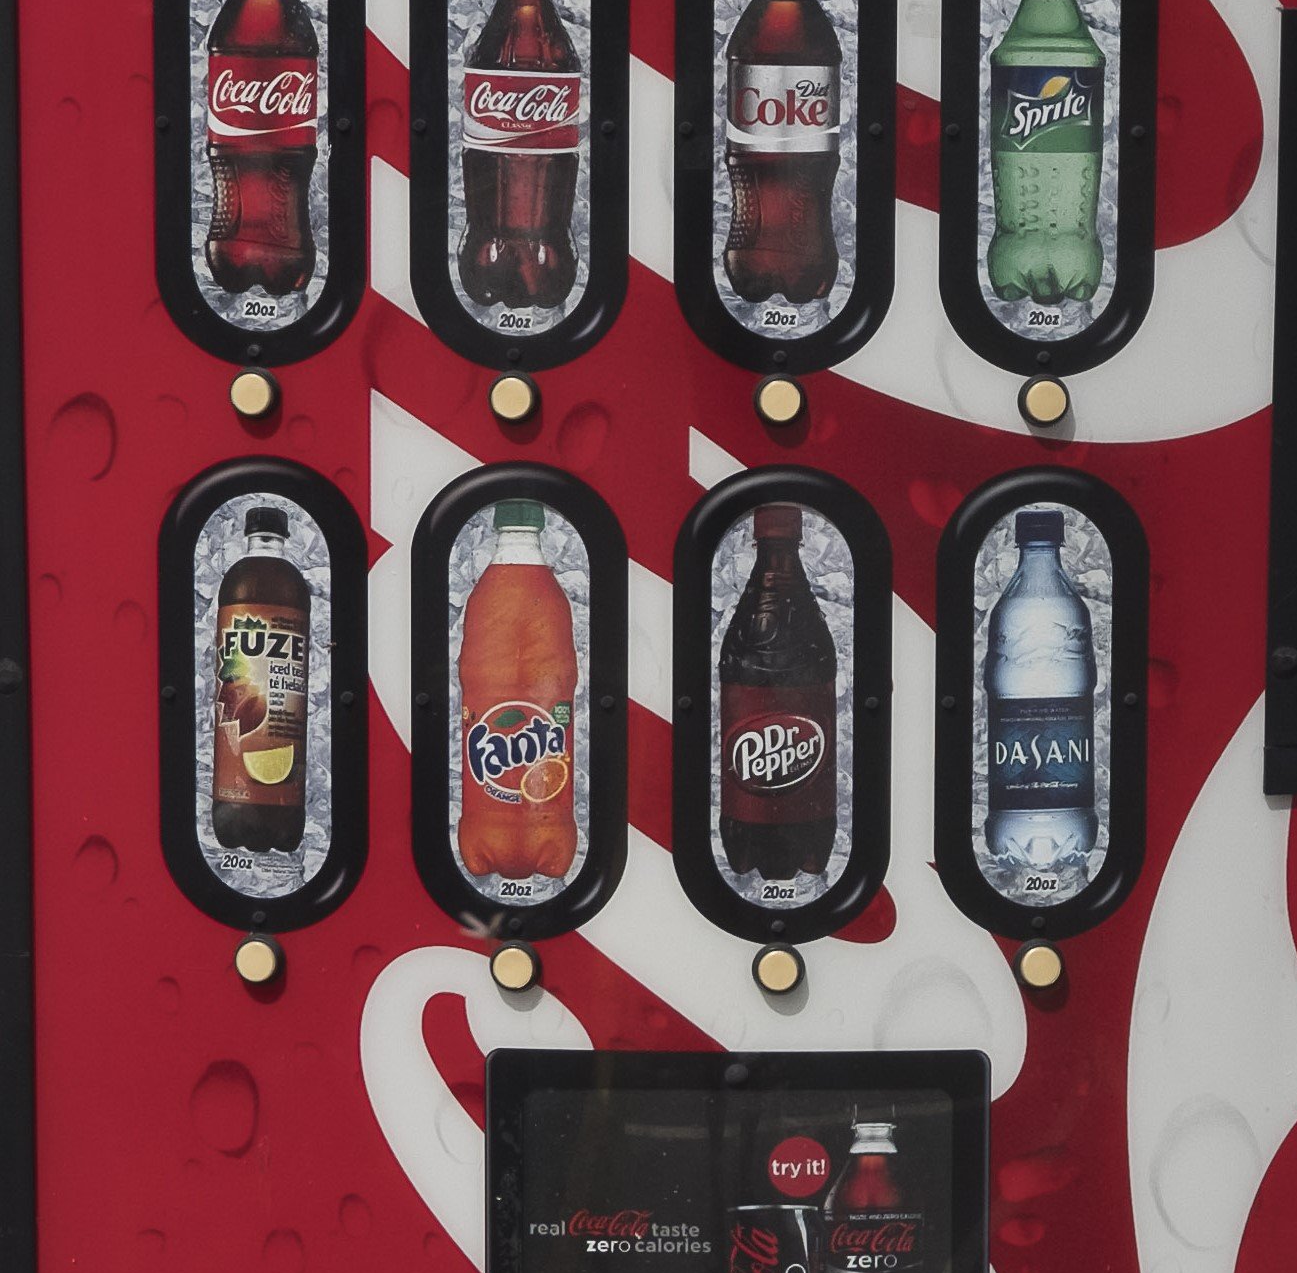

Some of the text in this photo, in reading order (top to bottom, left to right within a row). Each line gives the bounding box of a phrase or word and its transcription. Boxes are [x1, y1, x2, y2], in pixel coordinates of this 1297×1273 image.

[212, 69, 315, 115] Coca-Cola
[470, 81, 572, 122] Coca-Cola
[735, 86, 828, 126] Coke
[1009, 86, 1085, 137] Sprite
[224, 631, 304, 662] FUZE
[269, 661, 290, 675] iced
[468, 717, 564, 783] Fanta
[764, 724, 800, 755] Dr
[995, 734, 1089, 770] DASANI
[733, 731, 820, 781] Pepper
[771, 1158, 826, 1179] try it!
[529, 1209, 700, 1238] real Coca-Cola taste
[830, 1223, 917, 1254] Coca-Cola
[586, 1237, 712, 1254] zero calories
[846, 1254, 898, 1268] zero
